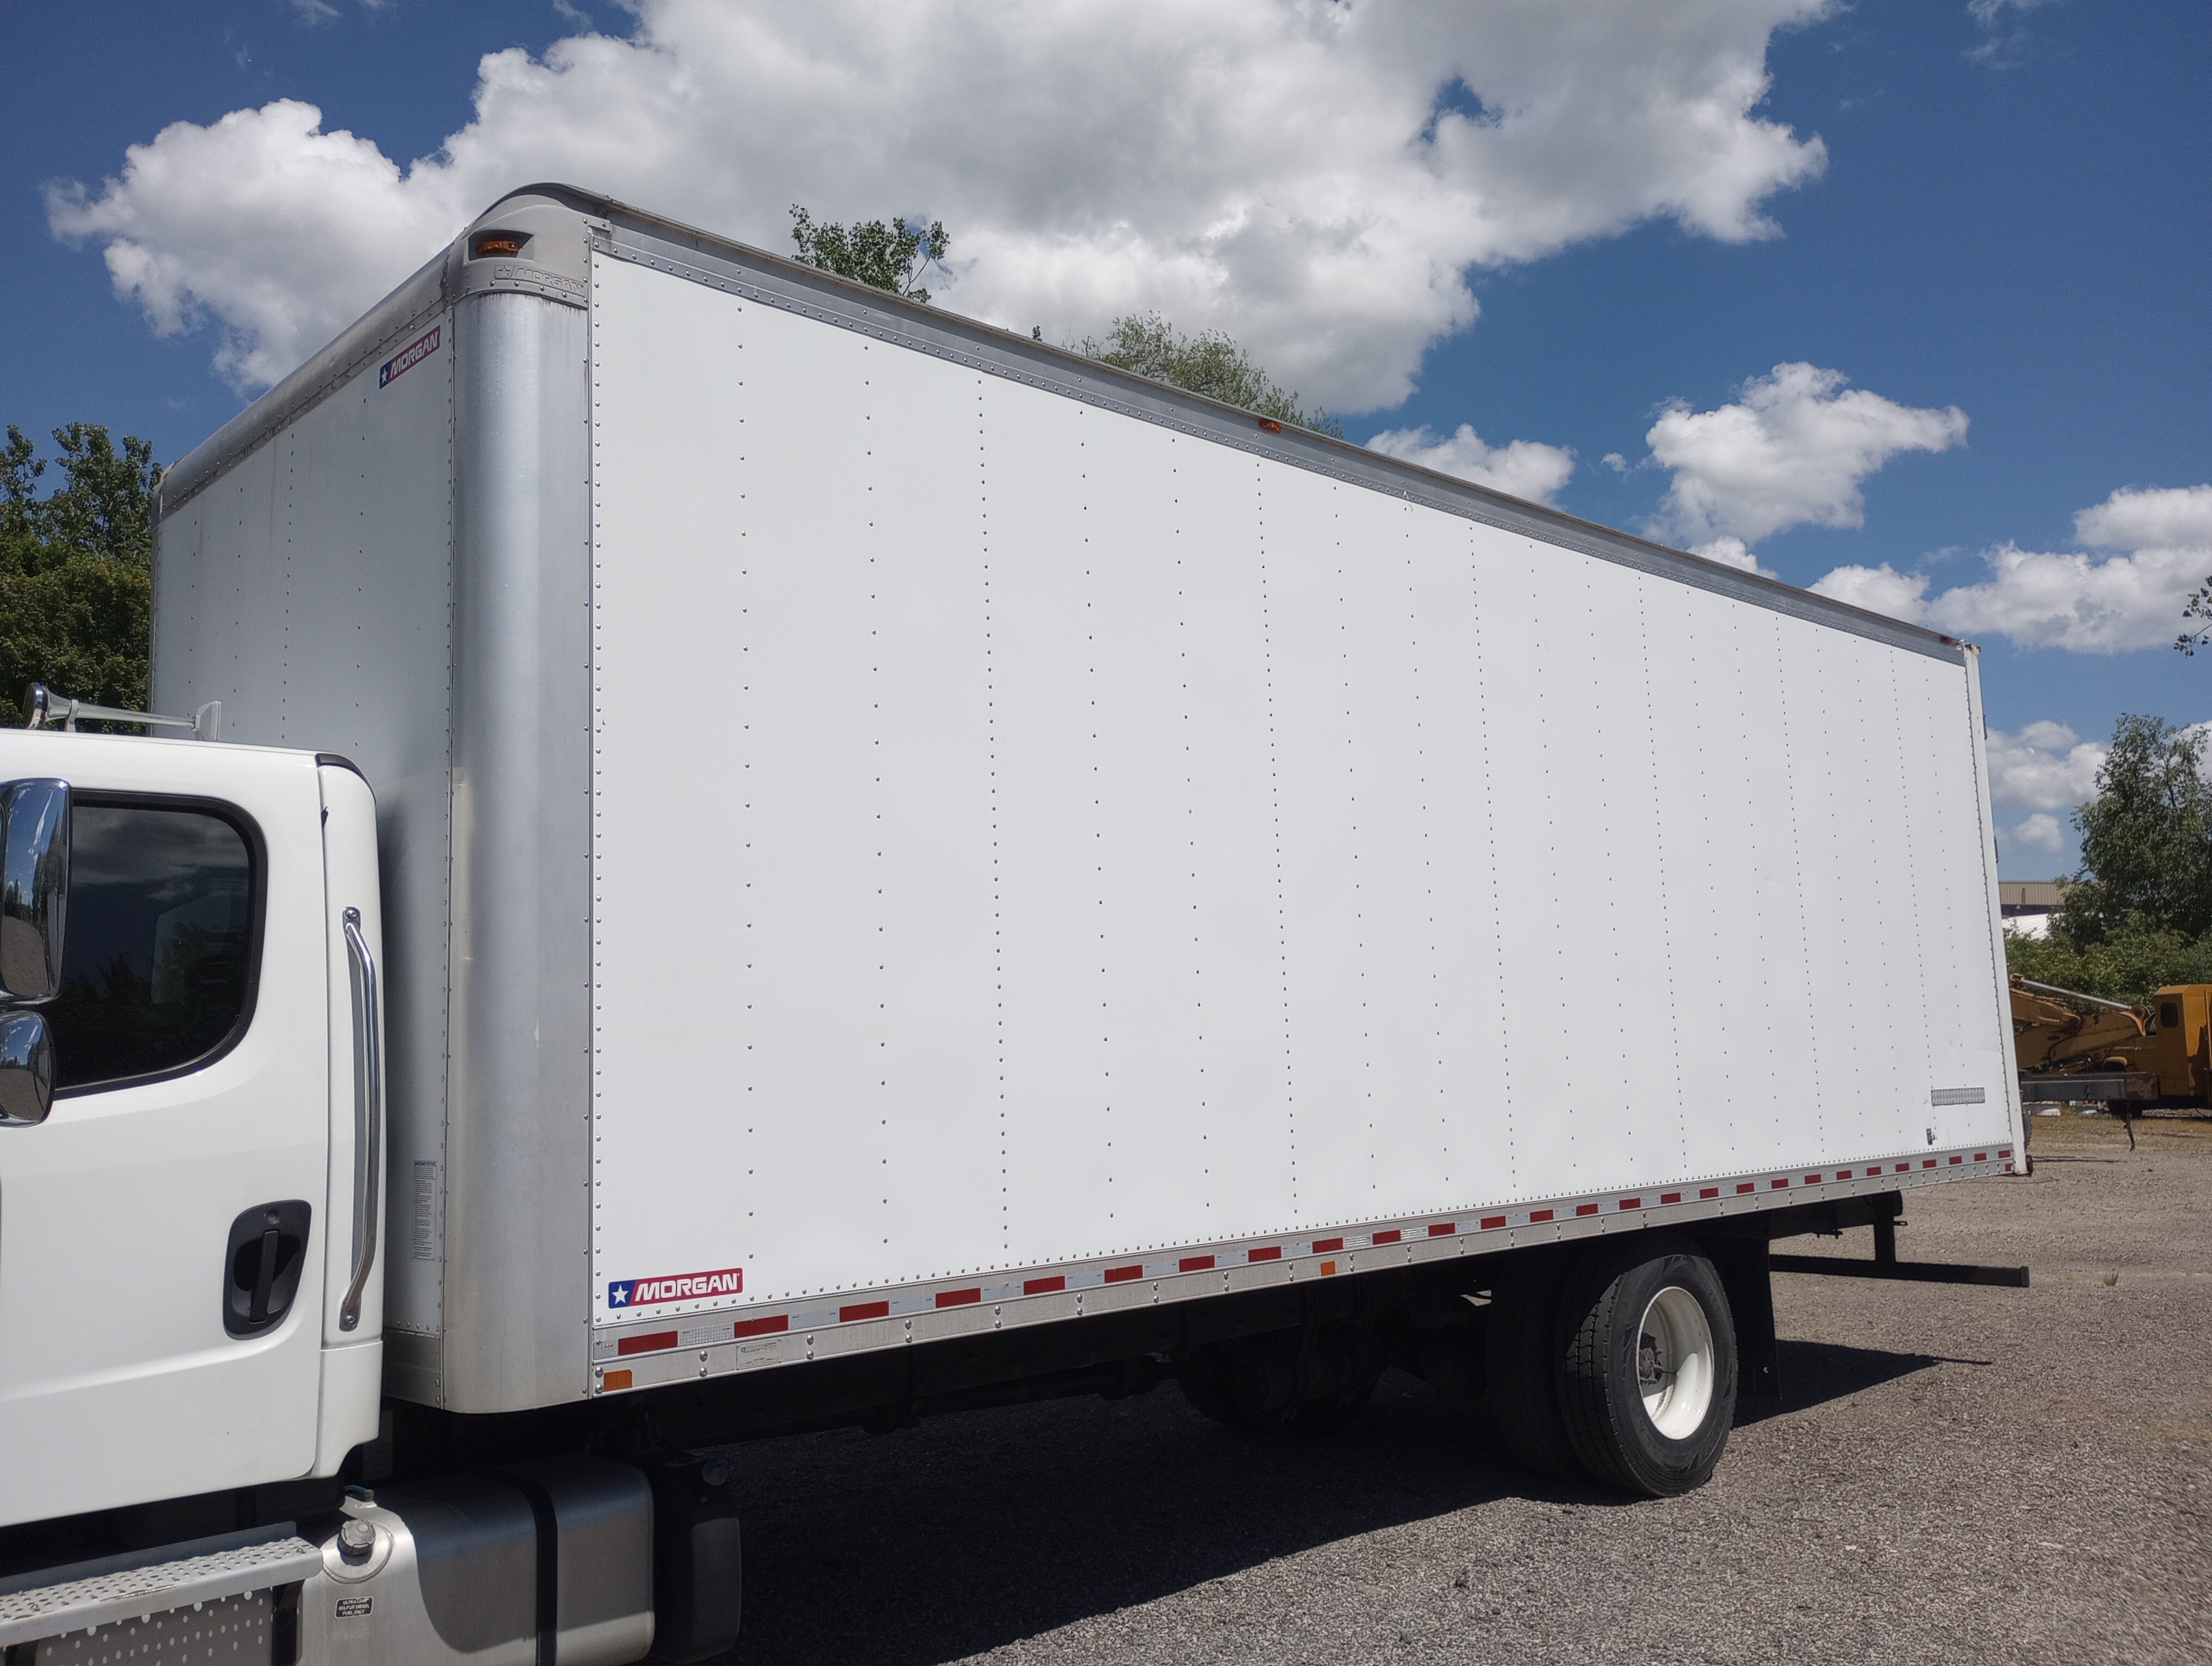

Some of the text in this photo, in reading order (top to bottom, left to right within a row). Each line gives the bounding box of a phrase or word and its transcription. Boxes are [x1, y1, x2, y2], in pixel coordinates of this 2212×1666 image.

[516, 268, 582, 292] MORGAN
[390, 332, 439, 379] MORGAN
[635, 1273, 738, 1302] MORGAN
